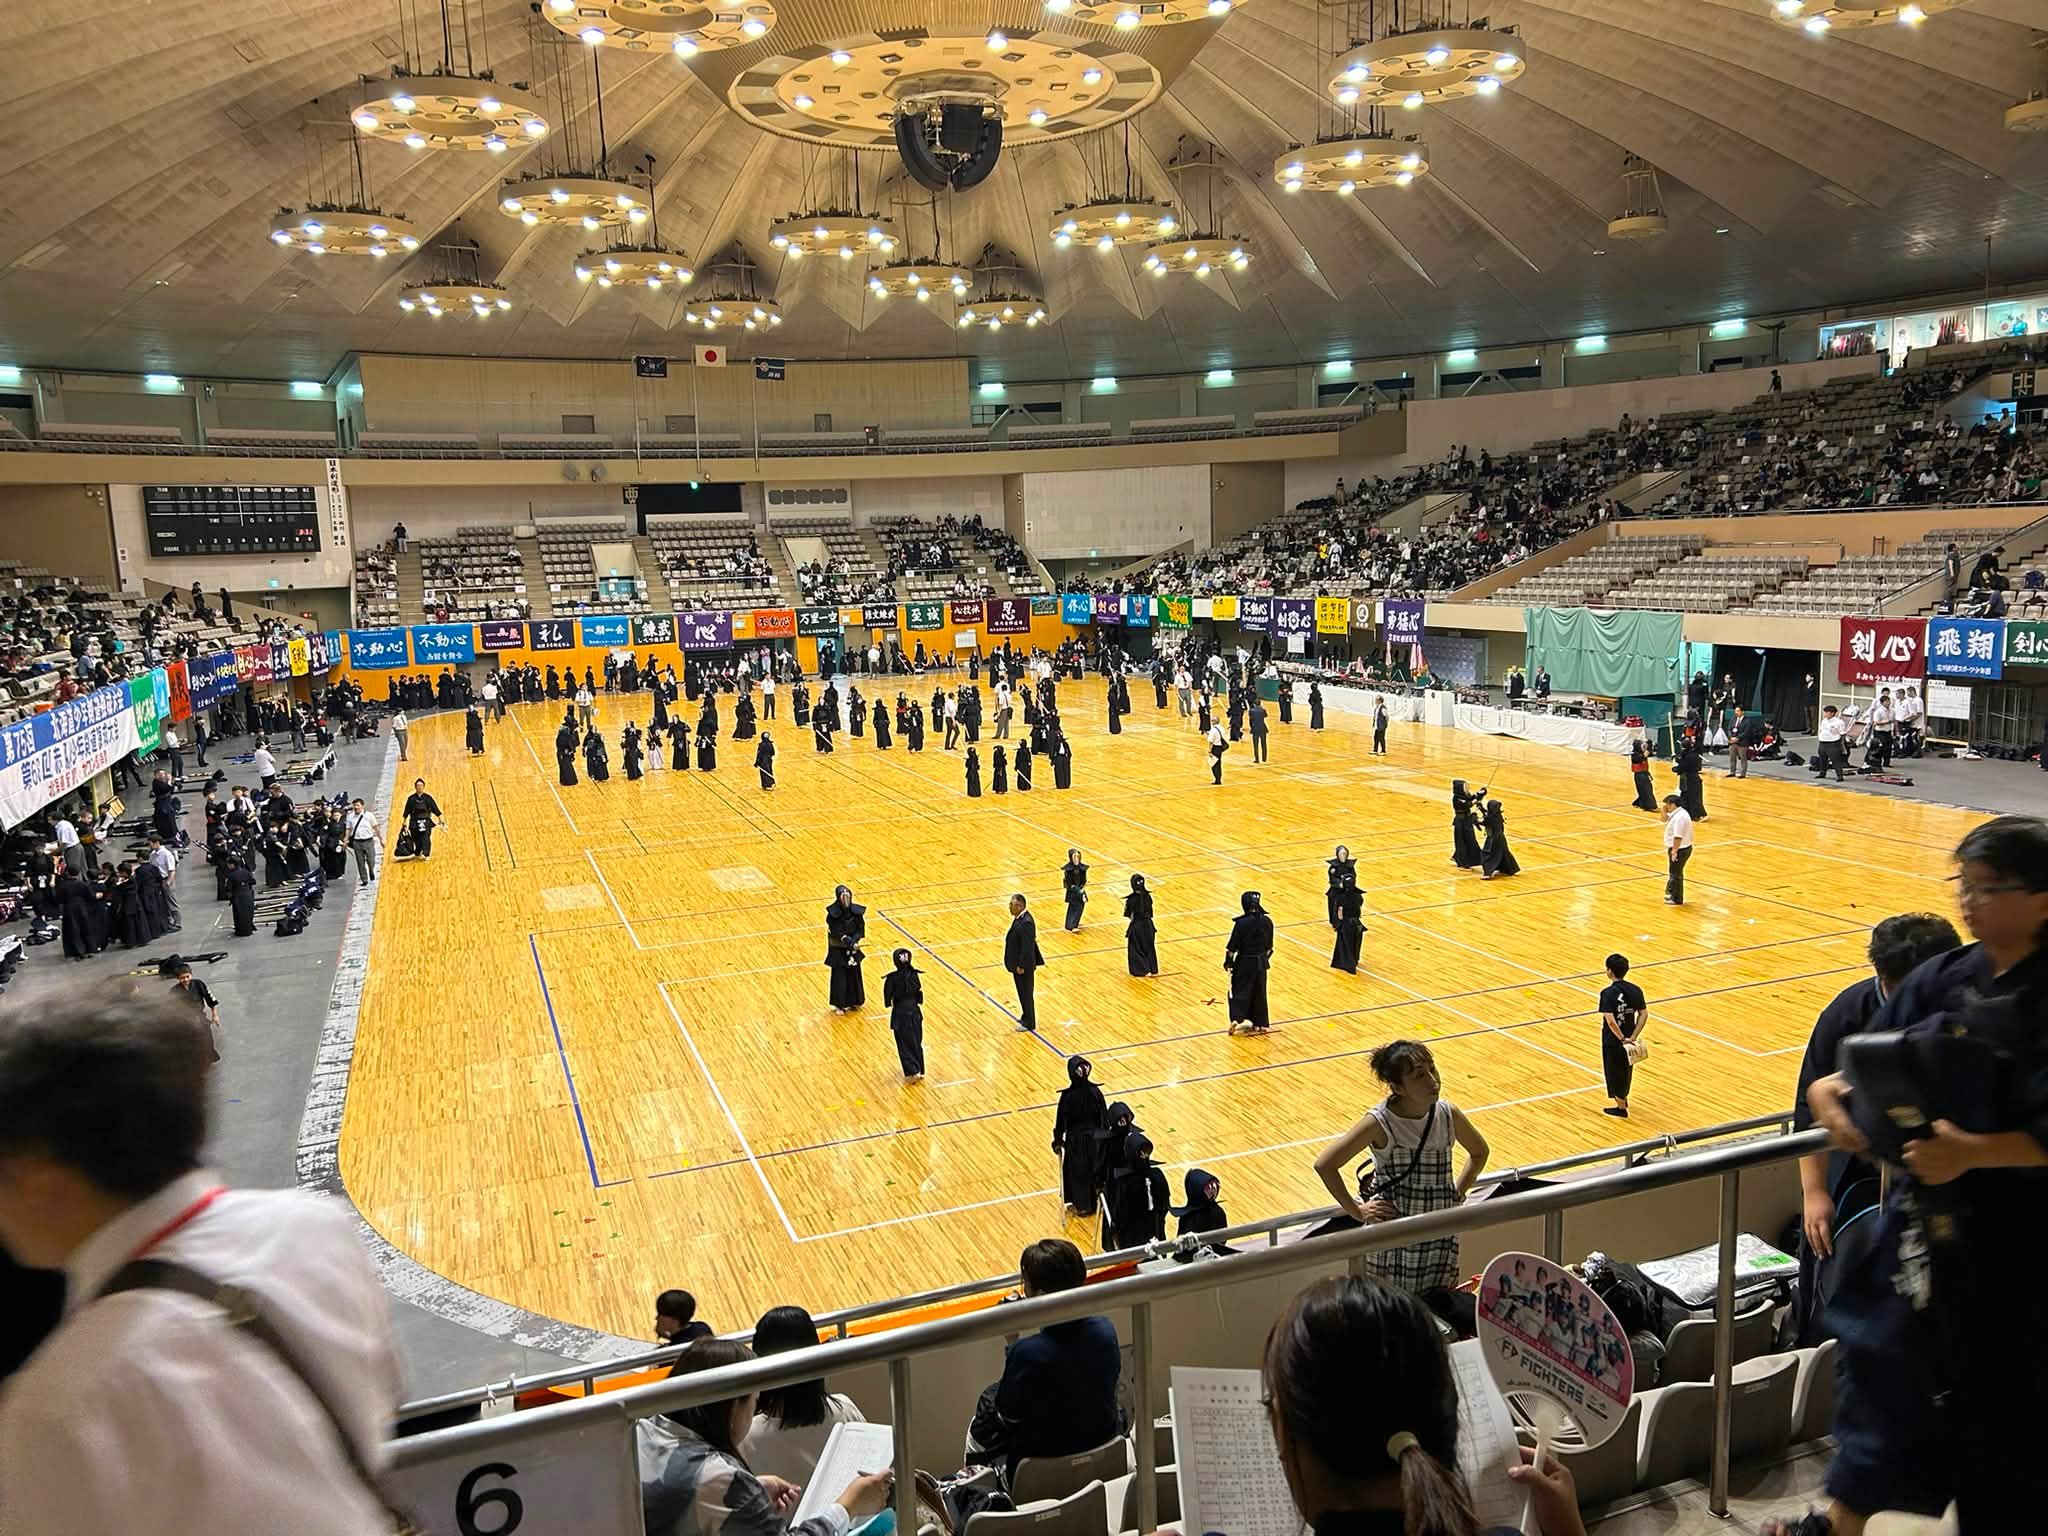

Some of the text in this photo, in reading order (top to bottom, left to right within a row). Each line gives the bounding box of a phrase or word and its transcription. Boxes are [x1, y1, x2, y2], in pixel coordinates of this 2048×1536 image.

[2014, 372, 2033, 389] 北
[1001, 600, 1016, 621] 忍
[419, 631, 468, 648] 不動心
[539, 623, 563, 642] 礼
[353, 640, 404, 656] 不動心
[1850, 628, 1917, 663] 剣心
[1934, 628, 1995, 660] 飛翔
[1520, 1355, 1584, 1405] FIGHTERS
[456, 1462, 523, 1536] 6
